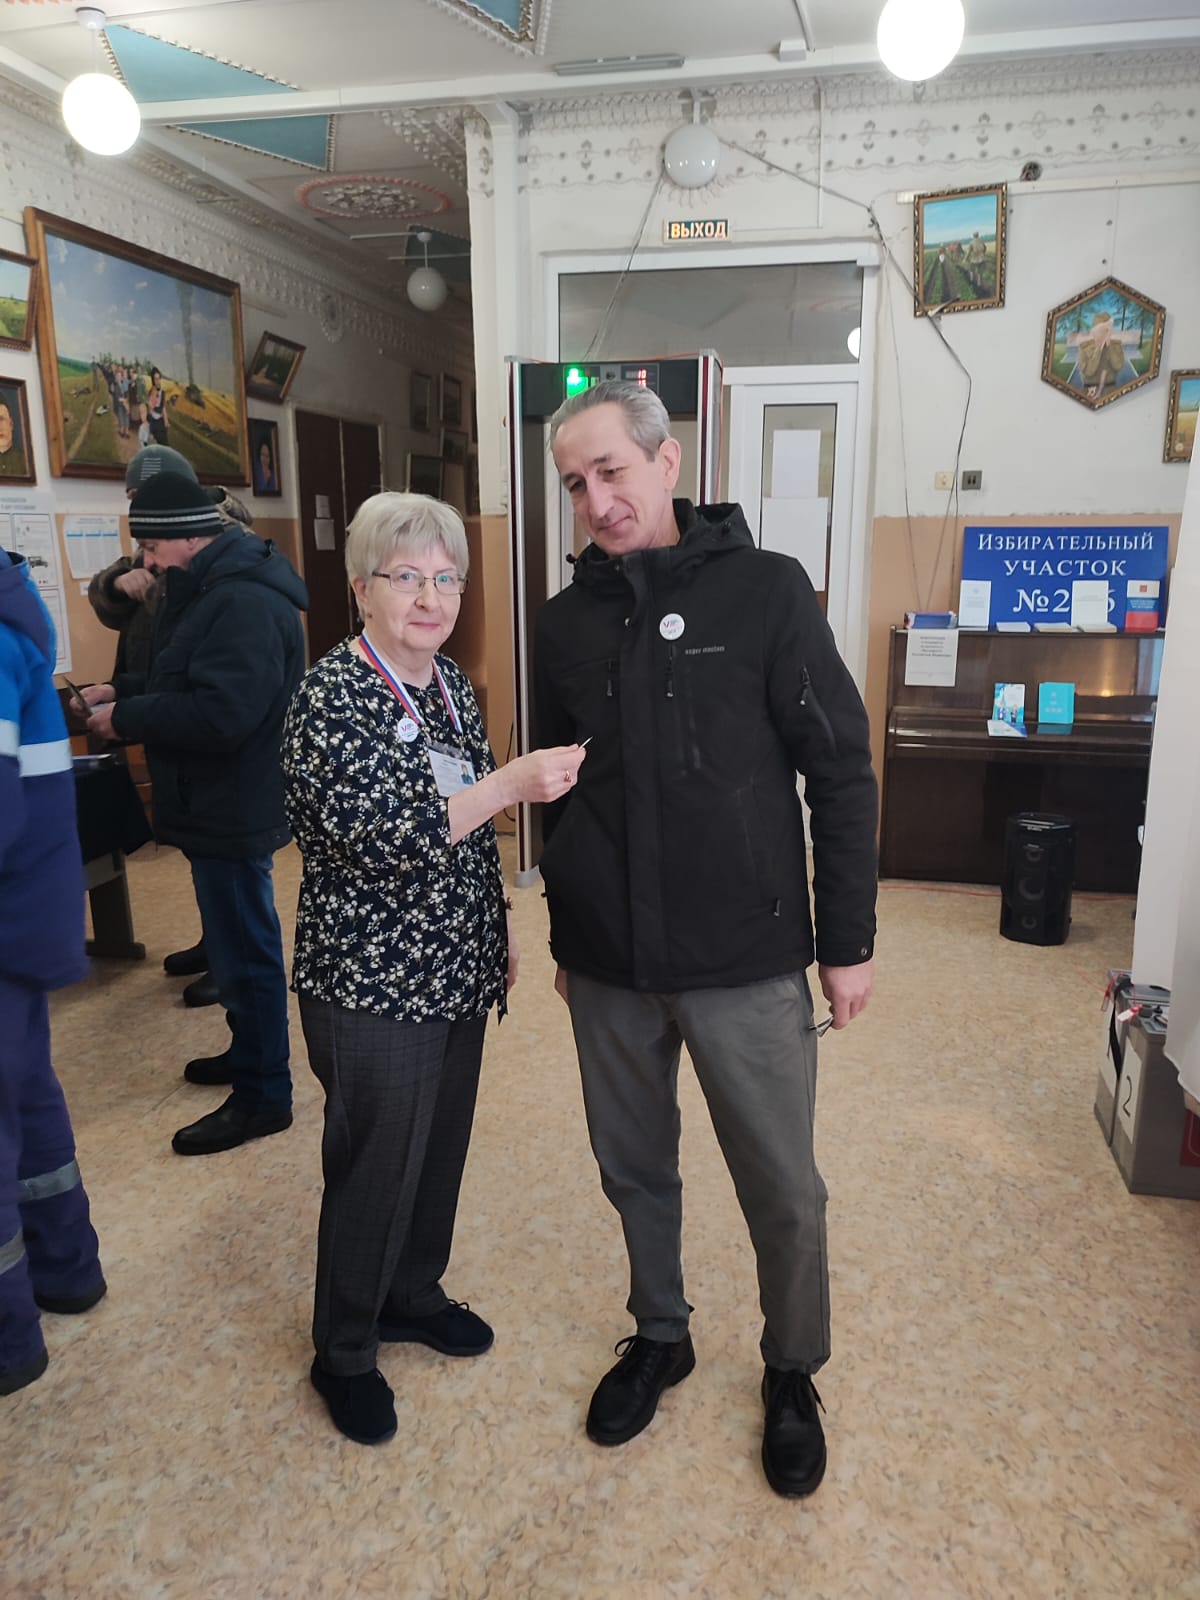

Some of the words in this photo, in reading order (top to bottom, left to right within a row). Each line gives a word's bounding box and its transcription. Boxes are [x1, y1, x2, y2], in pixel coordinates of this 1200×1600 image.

[671, 221, 726, 239] ВЫХОД
[978, 532, 1154, 551] ИЗБИРАТЕЛЬНЫЙ
[1003, 559, 1127, 577] УЧАСТОК
